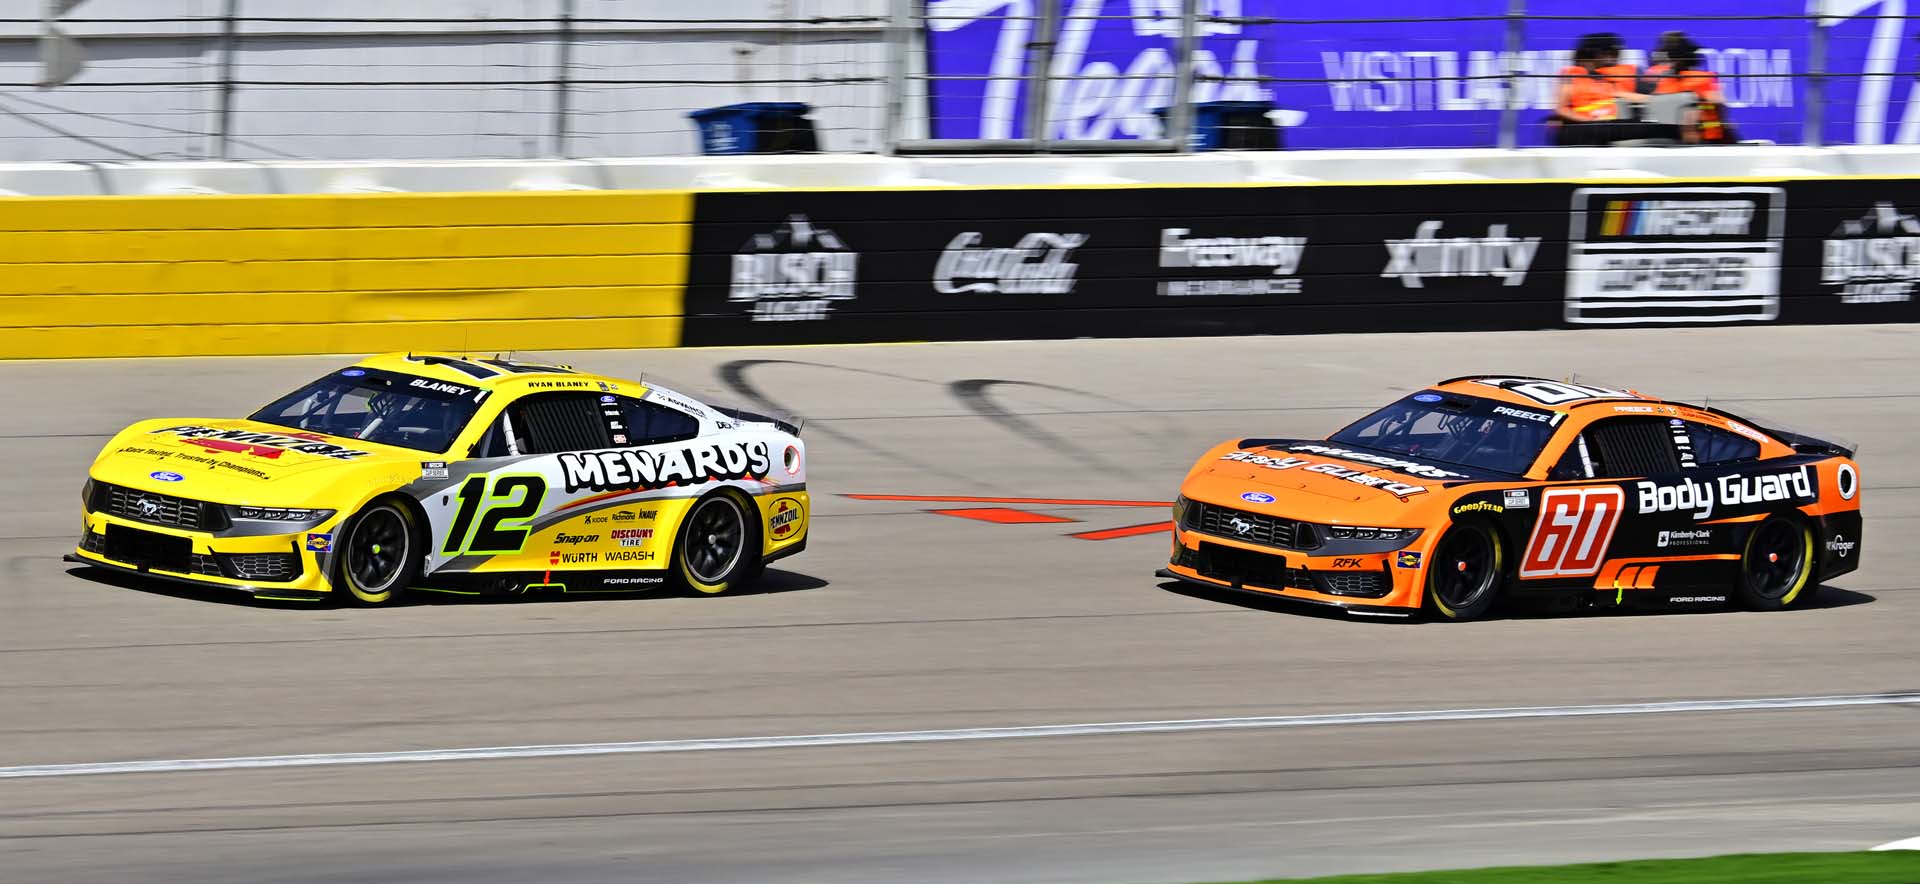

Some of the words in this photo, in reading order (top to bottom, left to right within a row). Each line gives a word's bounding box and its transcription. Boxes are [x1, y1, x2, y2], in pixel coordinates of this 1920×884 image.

[1159, 228, 1307, 275] Freeway
[1380, 220, 1543, 288] xfinity
[729, 252, 858, 301] BUSCH
[409, 378, 471, 396] BLANEY
[555, 380, 589, 388] BLANEY
[1493, 405, 1550, 423] PREECE
[1638, 476, 1714, 520] Body
[1717, 464, 1813, 506] Guard
[442, 472, 549, 556] 12
[639, 508, 658, 521] KNAUF
[1453, 500, 1504, 515] GOODYEAR
[554, 532, 600, 545] Snap-on
[611, 528, 654, 539] DISCOUNT
[1520, 486, 1624, 579] 60
[1831, 534, 1855, 558] Kroger
[562, 552, 598, 563] WÜRTH
[605, 551, 655, 561] WABASH
[1332, 558, 1364, 568] RFK
